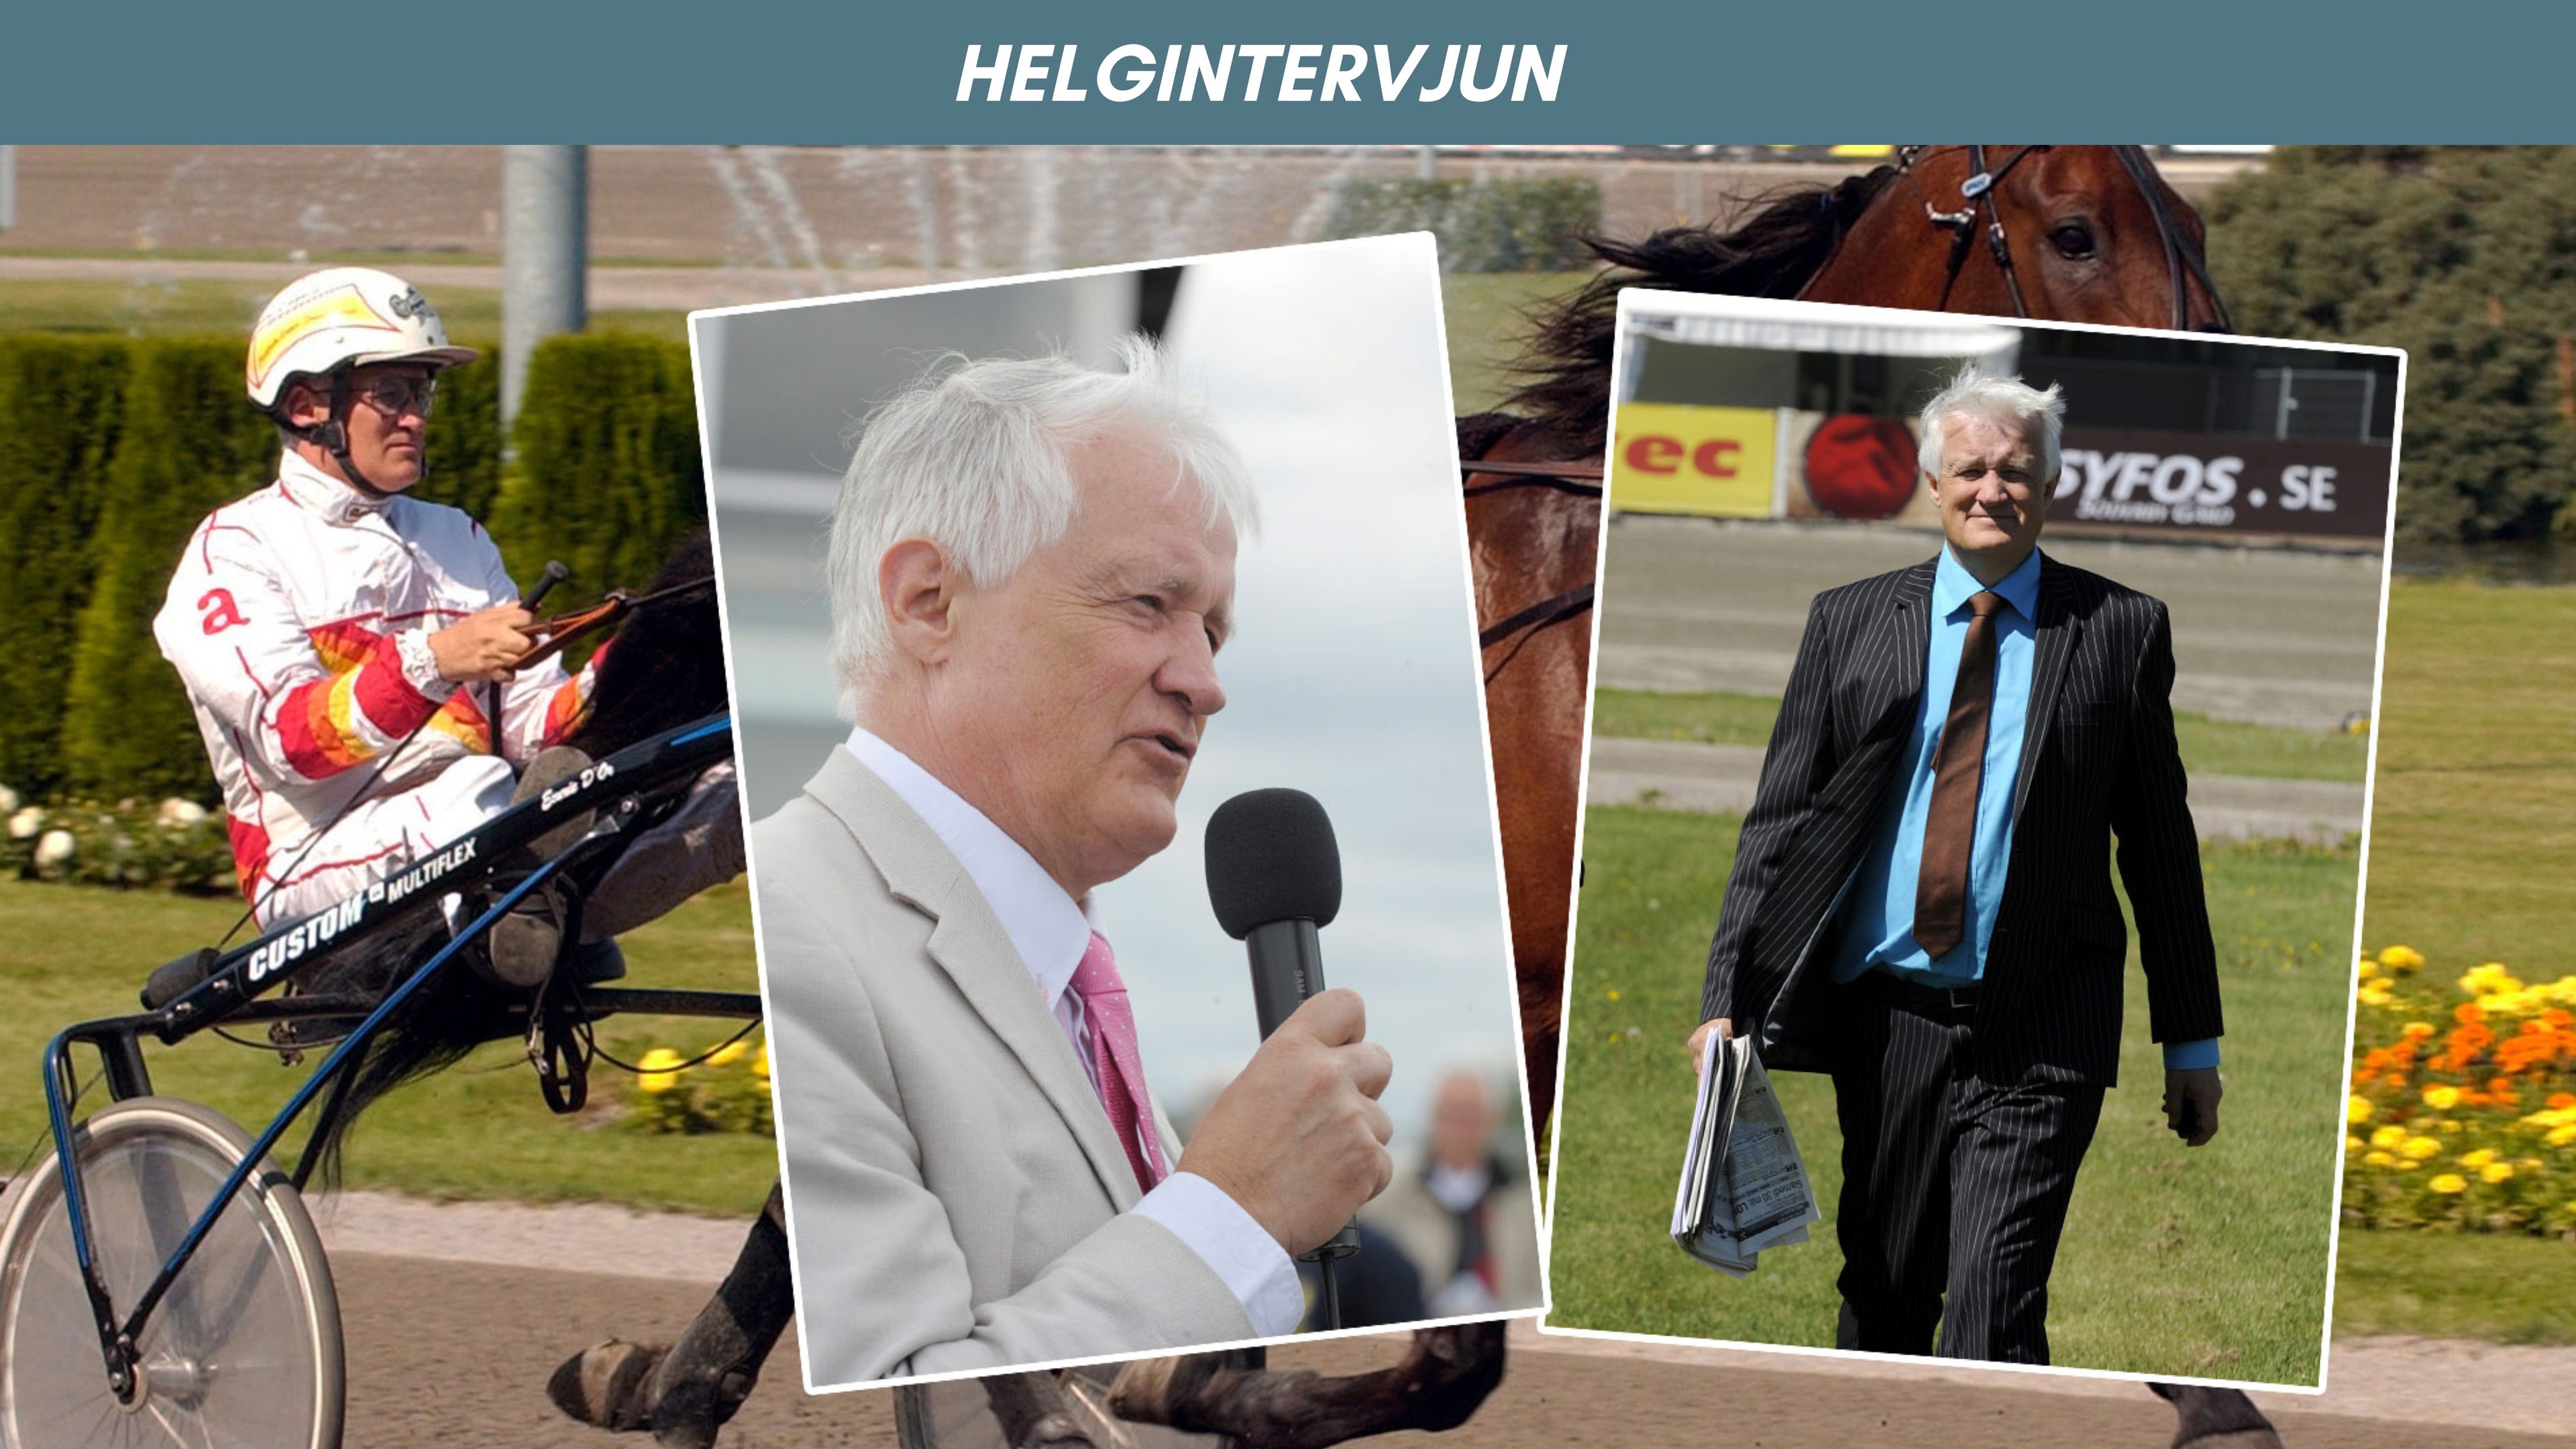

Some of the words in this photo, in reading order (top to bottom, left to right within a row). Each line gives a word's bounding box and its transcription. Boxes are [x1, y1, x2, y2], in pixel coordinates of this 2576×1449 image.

[2279, 464, 2338, 512] SE
[248, 889, 366, 981] CUSTOM
[388, 836, 477, 904] MULTIFLEX
